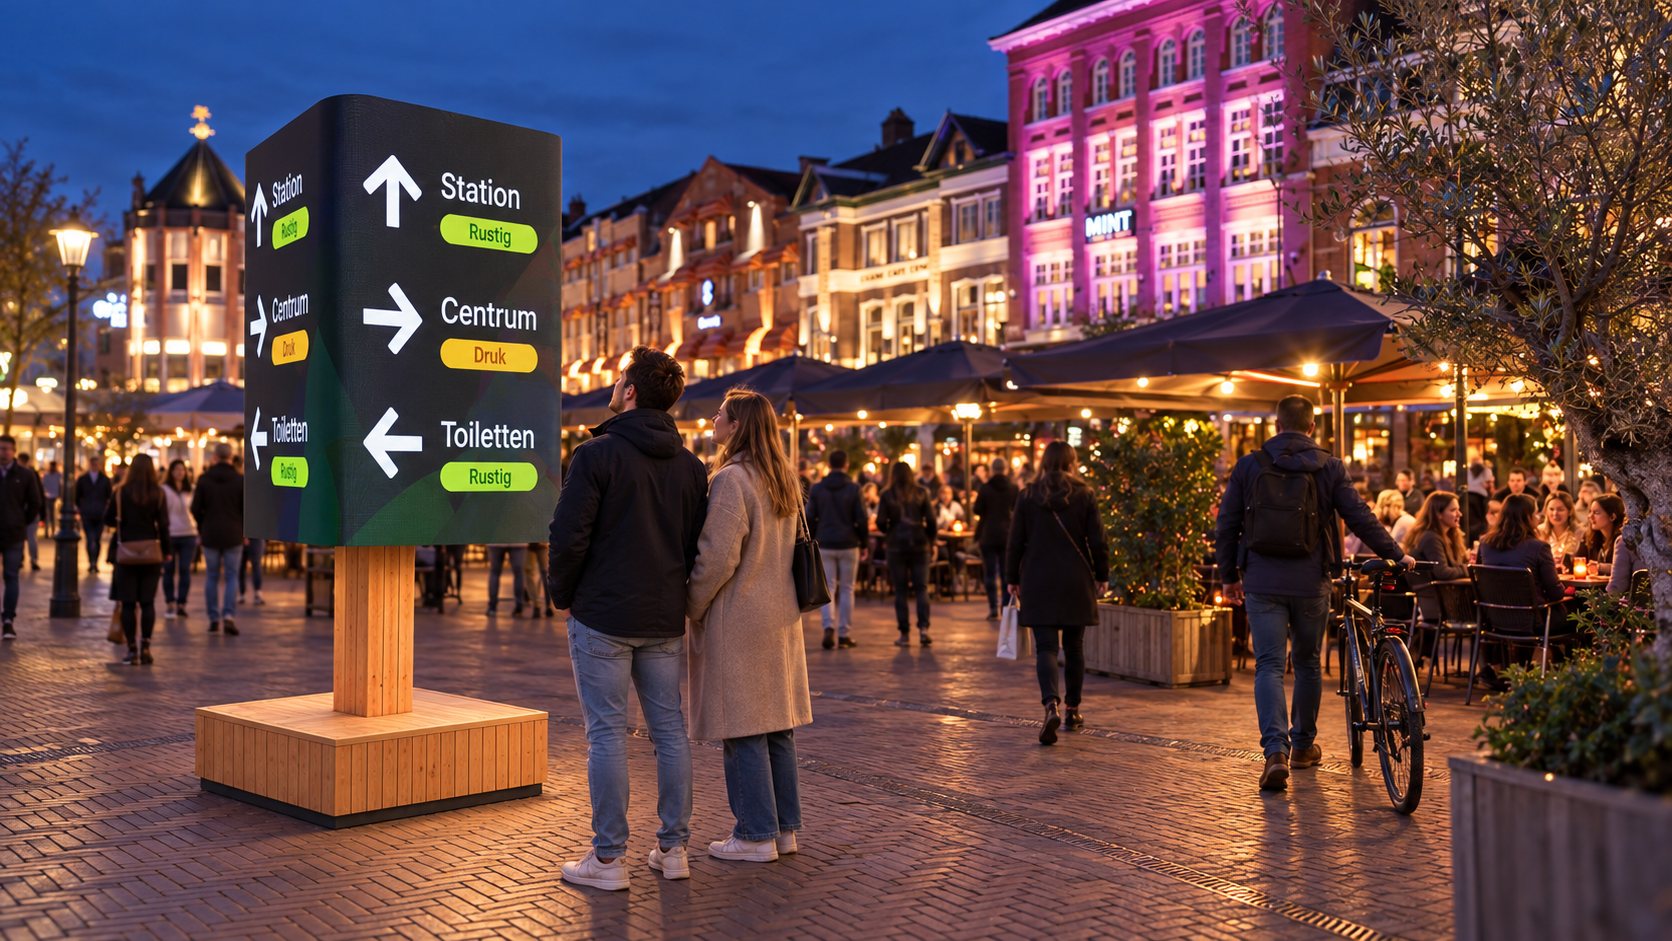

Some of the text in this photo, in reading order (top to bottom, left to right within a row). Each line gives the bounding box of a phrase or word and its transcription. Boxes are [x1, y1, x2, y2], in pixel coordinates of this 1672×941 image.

[273, 173, 303, 208] Station
[441, 172, 521, 209] Station
[282, 218, 297, 239] Rustig
[469, 223, 512, 248] Rustig
[1085, 209, 1132, 237] MINT
[272, 293, 308, 323] Centrum
[441, 297, 537, 331] Centrum
[283, 339, 295, 357] Druk
[474, 346, 507, 366] Druk
[272, 416, 308, 442] Toiletten
[441, 421, 535, 449] Toiletten
[281, 463, 297, 483] Rustig
[469, 467, 512, 489] Rustig
